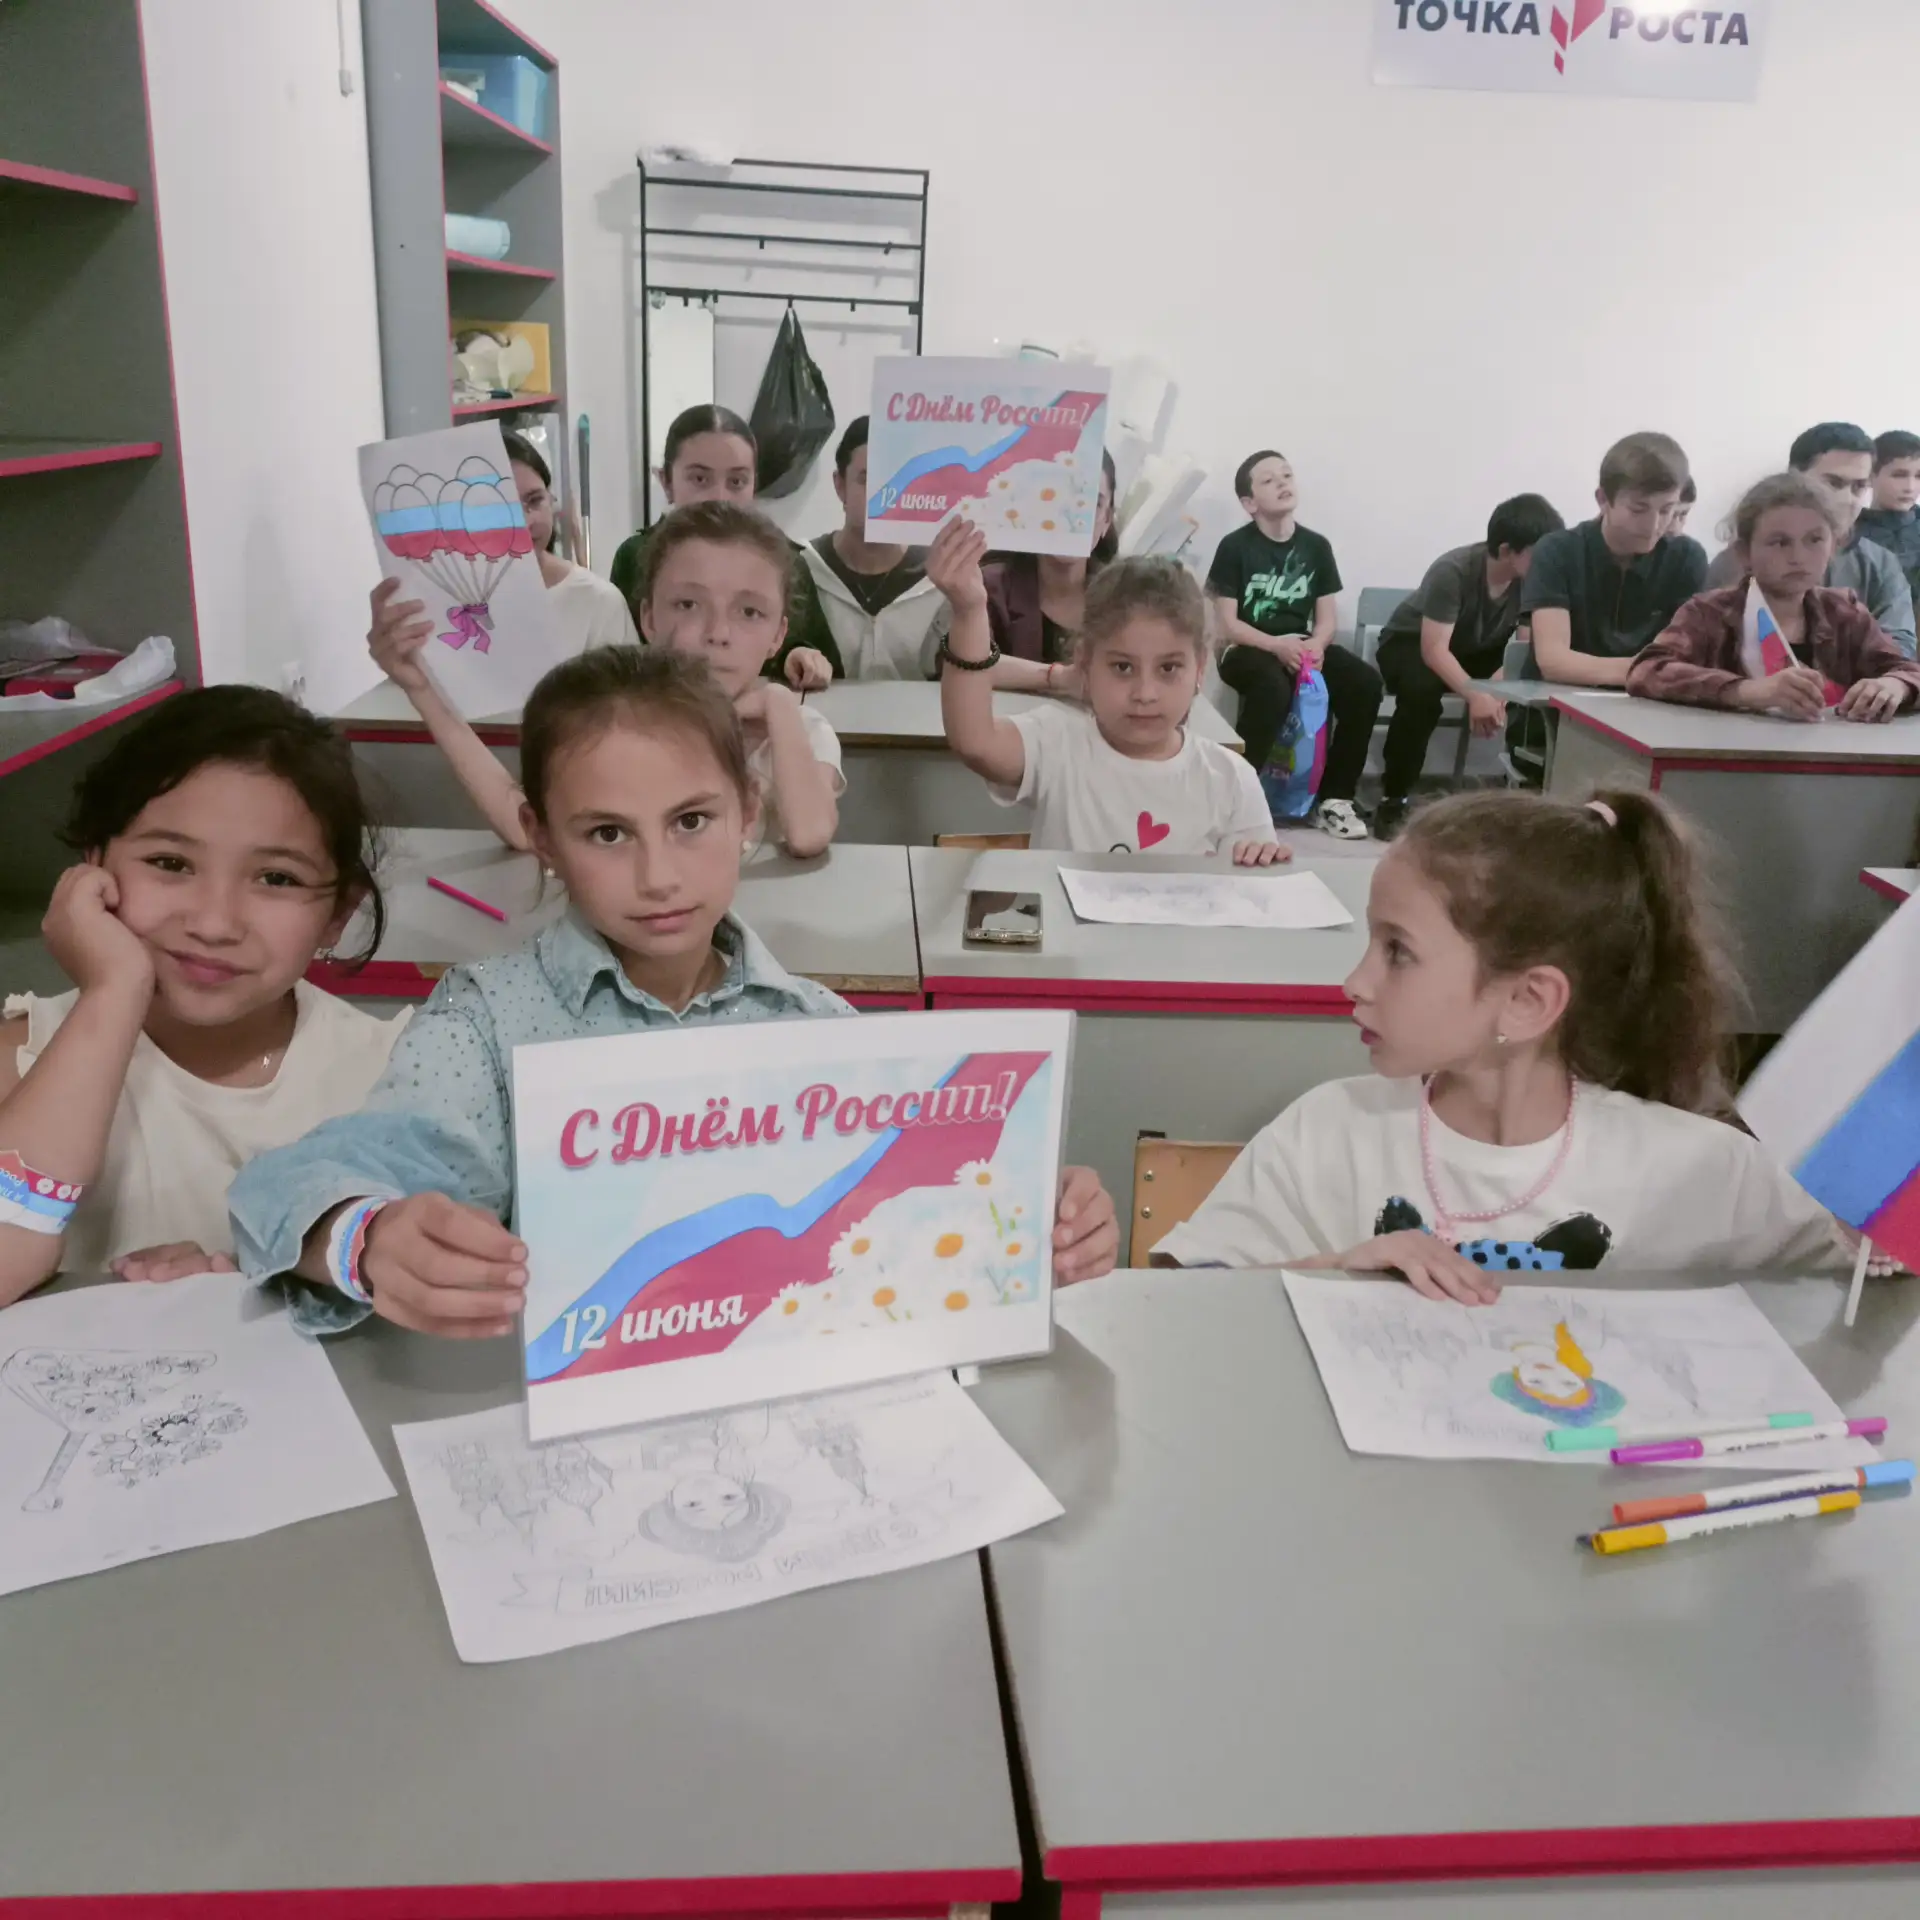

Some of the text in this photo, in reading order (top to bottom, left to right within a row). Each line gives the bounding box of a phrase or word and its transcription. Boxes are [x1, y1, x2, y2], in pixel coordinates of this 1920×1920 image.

[1394, 0, 1749, 46] ТОЧКА РОСТА
[887, 392, 1091, 427] С Днём России!
[880, 487, 948, 511] 12 июня
[1244, 572, 1310, 604] FILA
[559, 1070, 1019, 1168] С Днём России!
[562, 1295, 748, 1354] 12 июня
